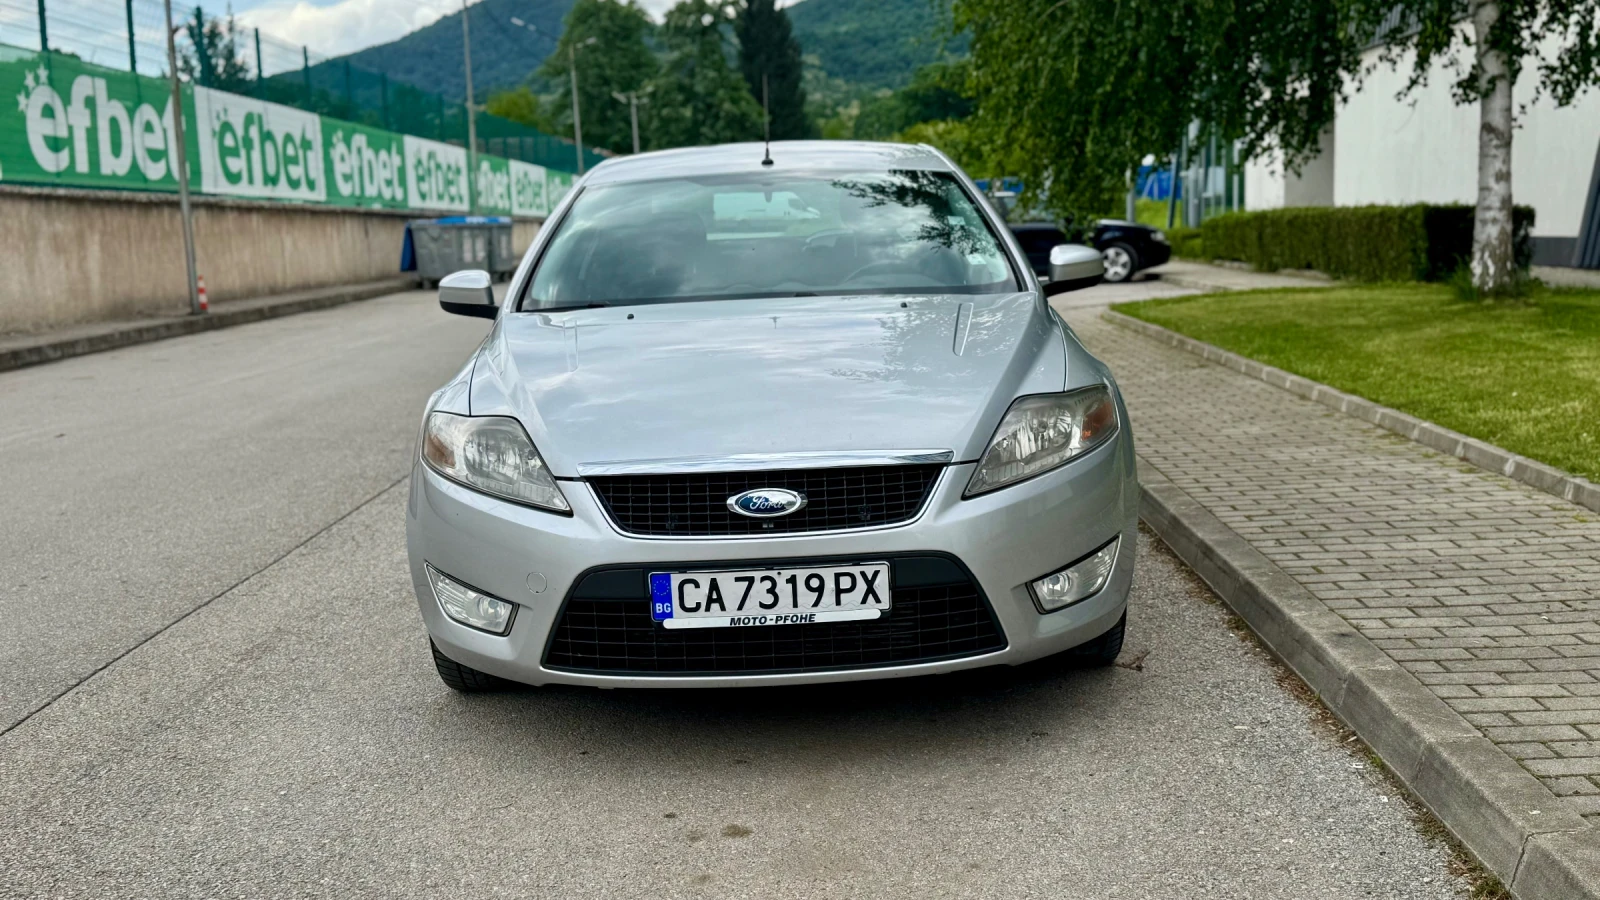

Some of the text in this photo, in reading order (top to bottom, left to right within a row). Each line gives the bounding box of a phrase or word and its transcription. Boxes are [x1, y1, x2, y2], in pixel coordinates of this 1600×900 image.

[218, 112, 316, 192] efbet
[333, 132, 404, 201] efbet
[748, 495, 785, 510] Ford
[655, 602, 672, 614] BG
[729, 613, 816, 626] MOTO-PFOHE
